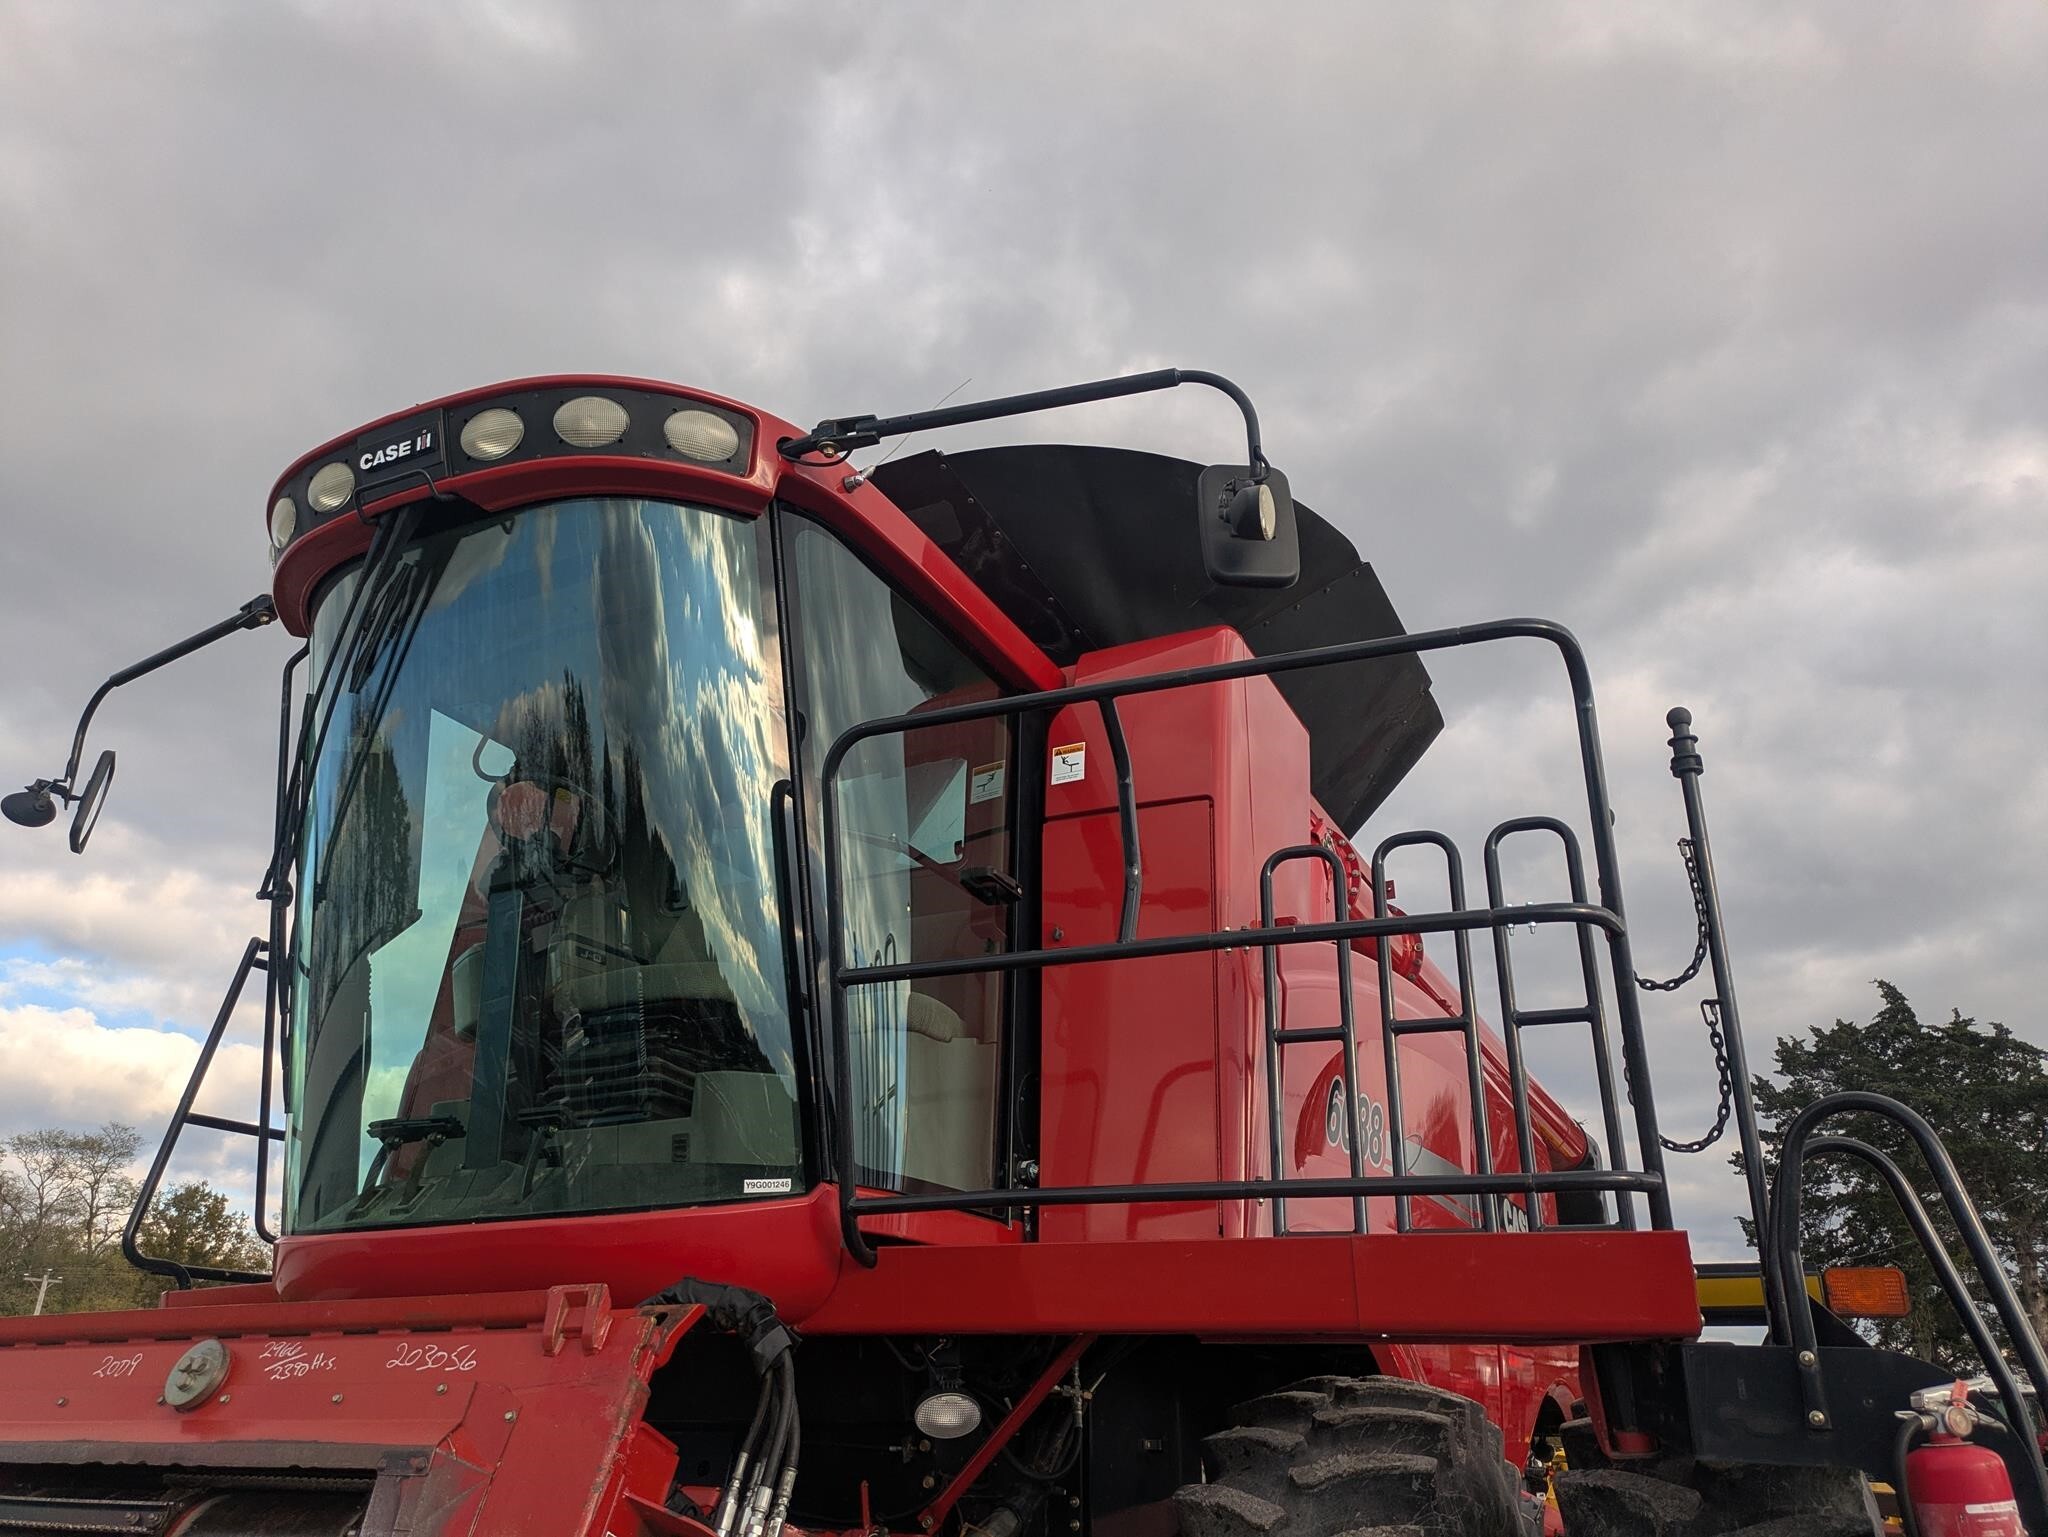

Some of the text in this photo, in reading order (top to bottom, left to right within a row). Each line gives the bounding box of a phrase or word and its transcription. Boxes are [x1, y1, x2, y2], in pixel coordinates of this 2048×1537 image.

[360, 440, 412, 470] CASE
[745, 1180, 790, 1189] Y9G001246
[1503, 1198, 1529, 1233] CAS
[92, 1352, 143, 1378] 2009
[386, 1342, 477, 1371] 203056
